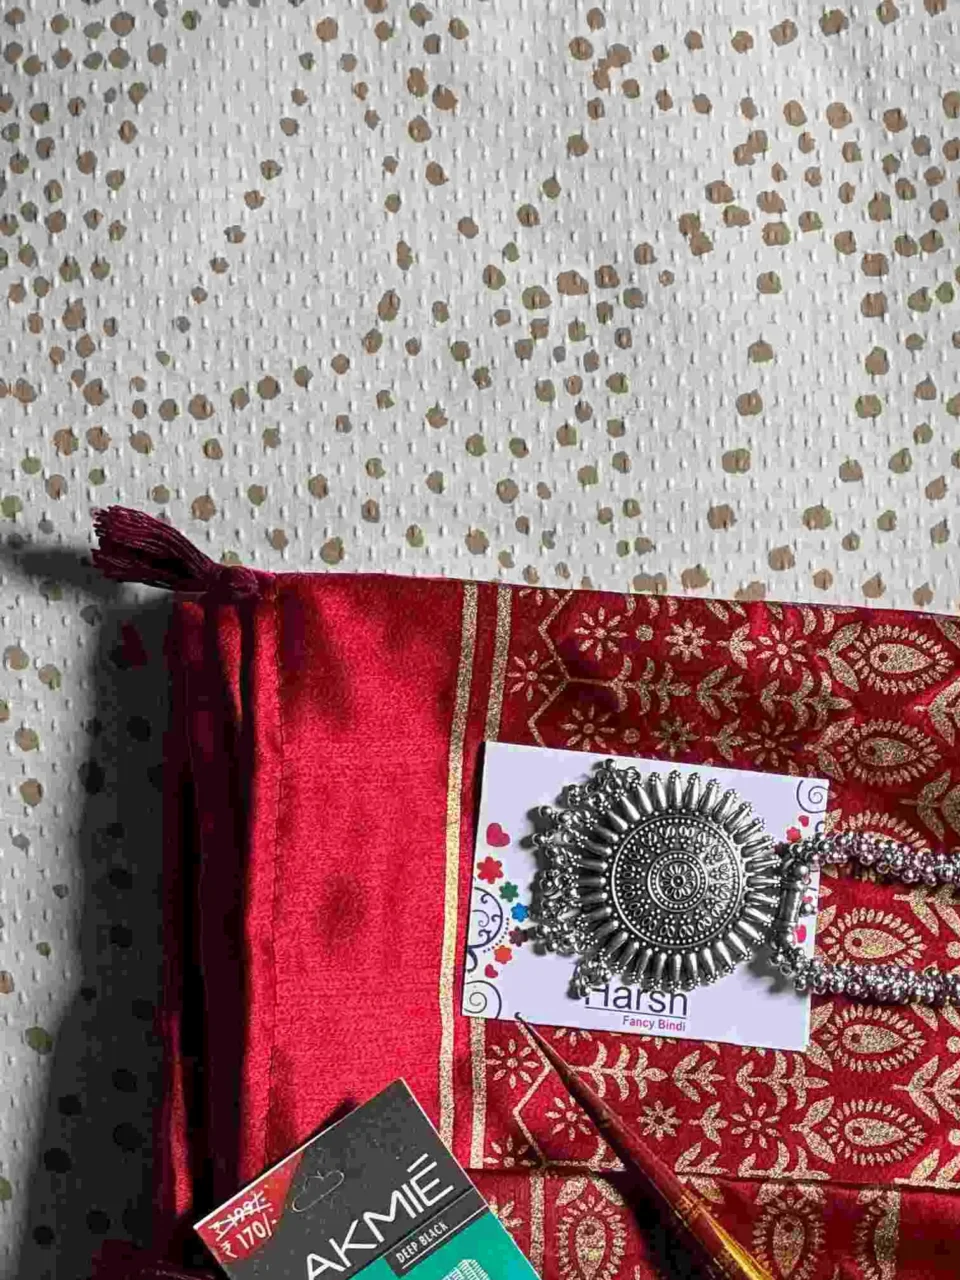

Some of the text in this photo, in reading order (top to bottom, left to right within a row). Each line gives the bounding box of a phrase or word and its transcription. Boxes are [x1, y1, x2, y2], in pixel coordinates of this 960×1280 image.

[584, 983, 688, 1017] Harsh
[622, 1015, 686, 1032] Fancy Bindi
[396, 1221, 449, 1264] DEEP BLACK
